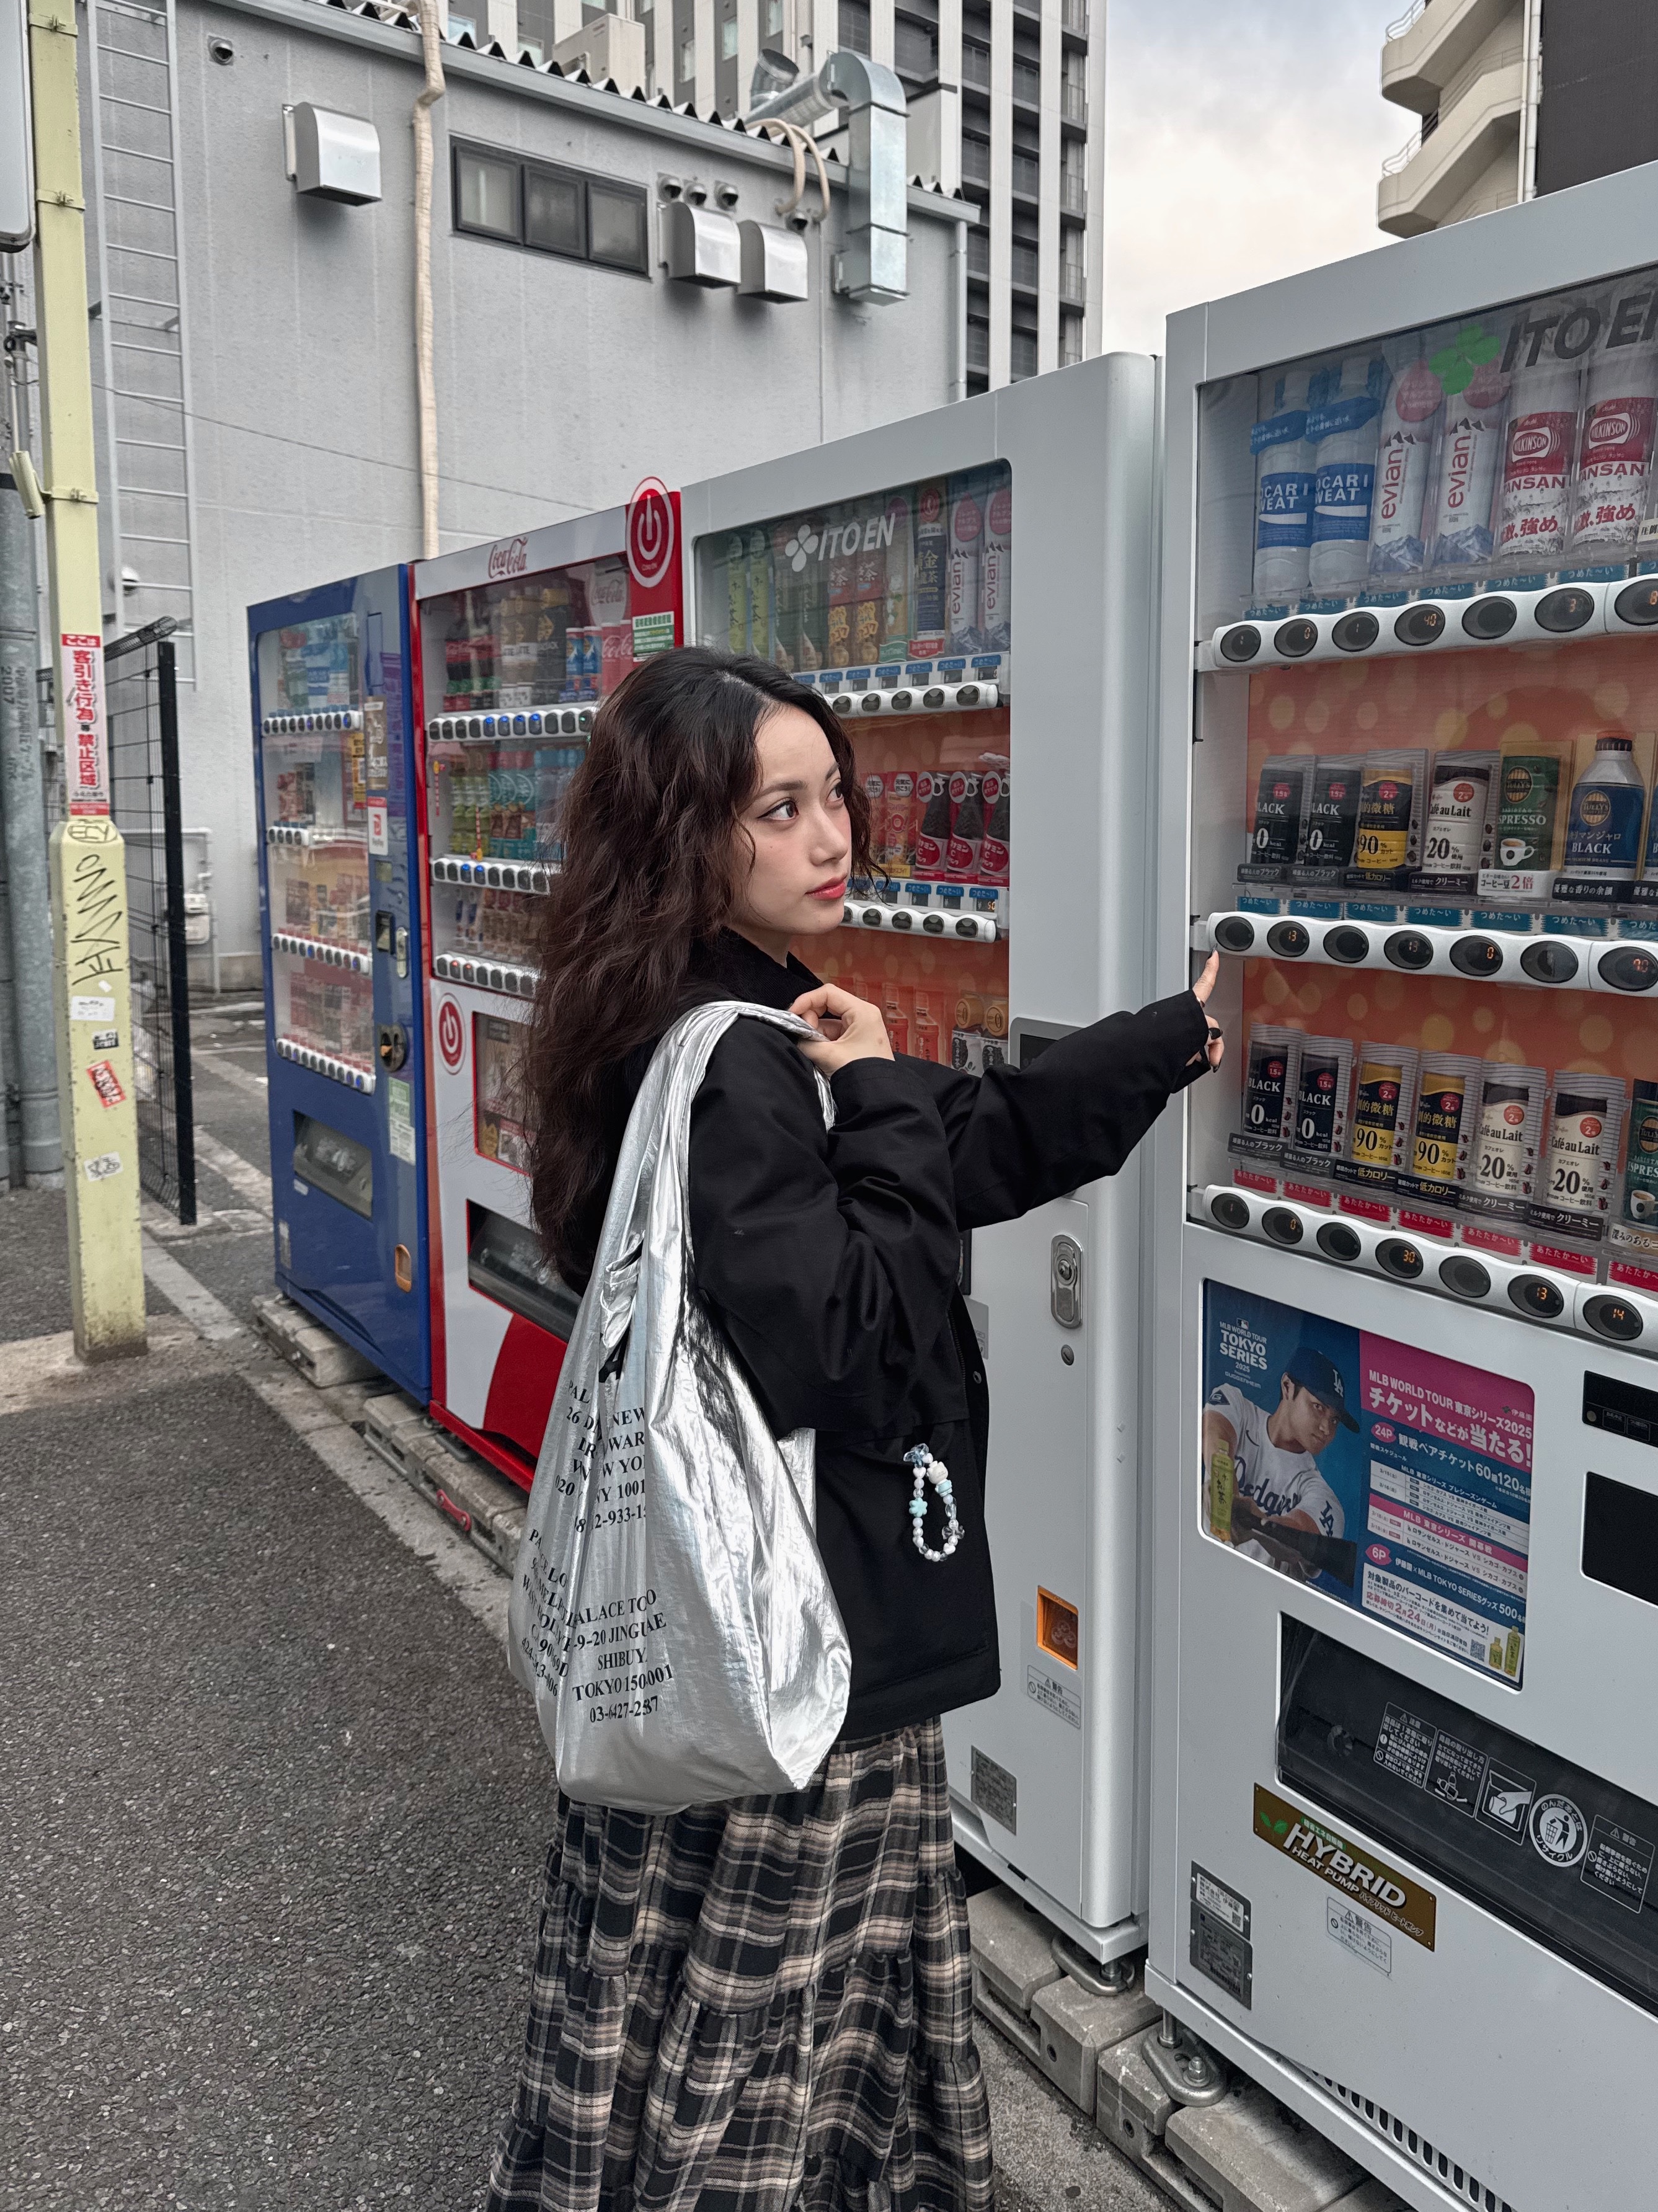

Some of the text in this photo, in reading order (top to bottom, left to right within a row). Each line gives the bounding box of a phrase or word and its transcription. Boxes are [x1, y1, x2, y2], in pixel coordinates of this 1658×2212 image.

[1501, 306, 1601, 373] ITO
[1592, 421, 1626, 438] WILKINSON
[1448, 435, 1471, 508] evian
[1381, 449, 1404, 519] evian
[818, 513, 895, 561] ITO EN
[952, 561, 961, 615] evian
[987, 554, 997, 610] evian
[1440, 806, 1472, 817] au Lait
[1427, 837, 1450, 859] 20
[1572, 842, 1613, 855] BLACK
[1435, 876, 1469, 887] クリーミー
[1248, 1077, 1281, 1093] BLACK
[1298, 1090, 1332, 1106] BLACK
[1251, 1104, 1265, 1125] 0
[1301, 1117, 1315, 1139] 0
[1491, 1128, 1523, 1142] au Lait
[1356, 1128, 1378, 1151] 90
[1564, 1142, 1577, 1153] au
[1578, 1142, 1600, 1155] Lait
[1418, 1141, 1440, 1165] 90
[1357, 1167, 1395, 1181] 低カロリー
[1480, 1154, 1505, 1179] 20
[1419, 1181, 1456, 1196] 低カロリー
[1553, 1168, 1580, 1194] 20
[1582, 1186, 1594, 1194] 使用
[1483, 1196, 1526, 1212] クリーミー
[1556, 1212, 1599, 1228] クリーミー
[1403, 1249, 1416, 1263] 30
[1220, 1321, 1267, 1344] MLB WORLD TOUR
[1220, 1330, 1266, 1356] TOKYO
[1220, 1343, 1267, 1370] SERIES
[1235, 1361, 1251, 1373] 2025
[569, 1380, 590, 1403] PAL
[567, 1406, 583, 1424] 26
[1369, 1369, 1533, 1440] MLB WORLD TOUR 東京シリーズ2025
[1369, 1387, 1532, 1468] チケットなどが当たる!
[1374, 1423, 1393, 1439] 24P
[608, 1431, 645, 1452] WAR
[619, 1454, 645, 1474] YO
[1401, 1464, 1415, 1477] MLB
[618, 1478, 645, 1499] 1001
[595, 1504, 646, 1530] 2-933-1
[1404, 1509, 1422, 1524] MLB
[1372, 1547, 1386, 1560] 6P
[1472, 1552, 1481, 1561] VS
[1471, 1565, 1481, 1574] VS
[1368, 1570, 1489, 1636] 対象製品のバーコードを集めて当てよう!
[1433, 1574, 1499, 1611] TOKYO SERIESグッズ
[598, 1646, 648, 1671] SHIBUY
[572, 1677, 623, 1702] TOKYO
[1541, 1800, 1583, 1832] のんだあとは
[1536, 1834, 1574, 1862] リサイクル
[1283, 1822, 1406, 1909] HYBRID
[1594, 1870, 1615, 1886] ください
[1292, 1846, 1325, 1871] HEAT
[1324, 1866, 1360, 1893] PUMP
[1391, 1911, 1425, 1937] ヒートポンプ
